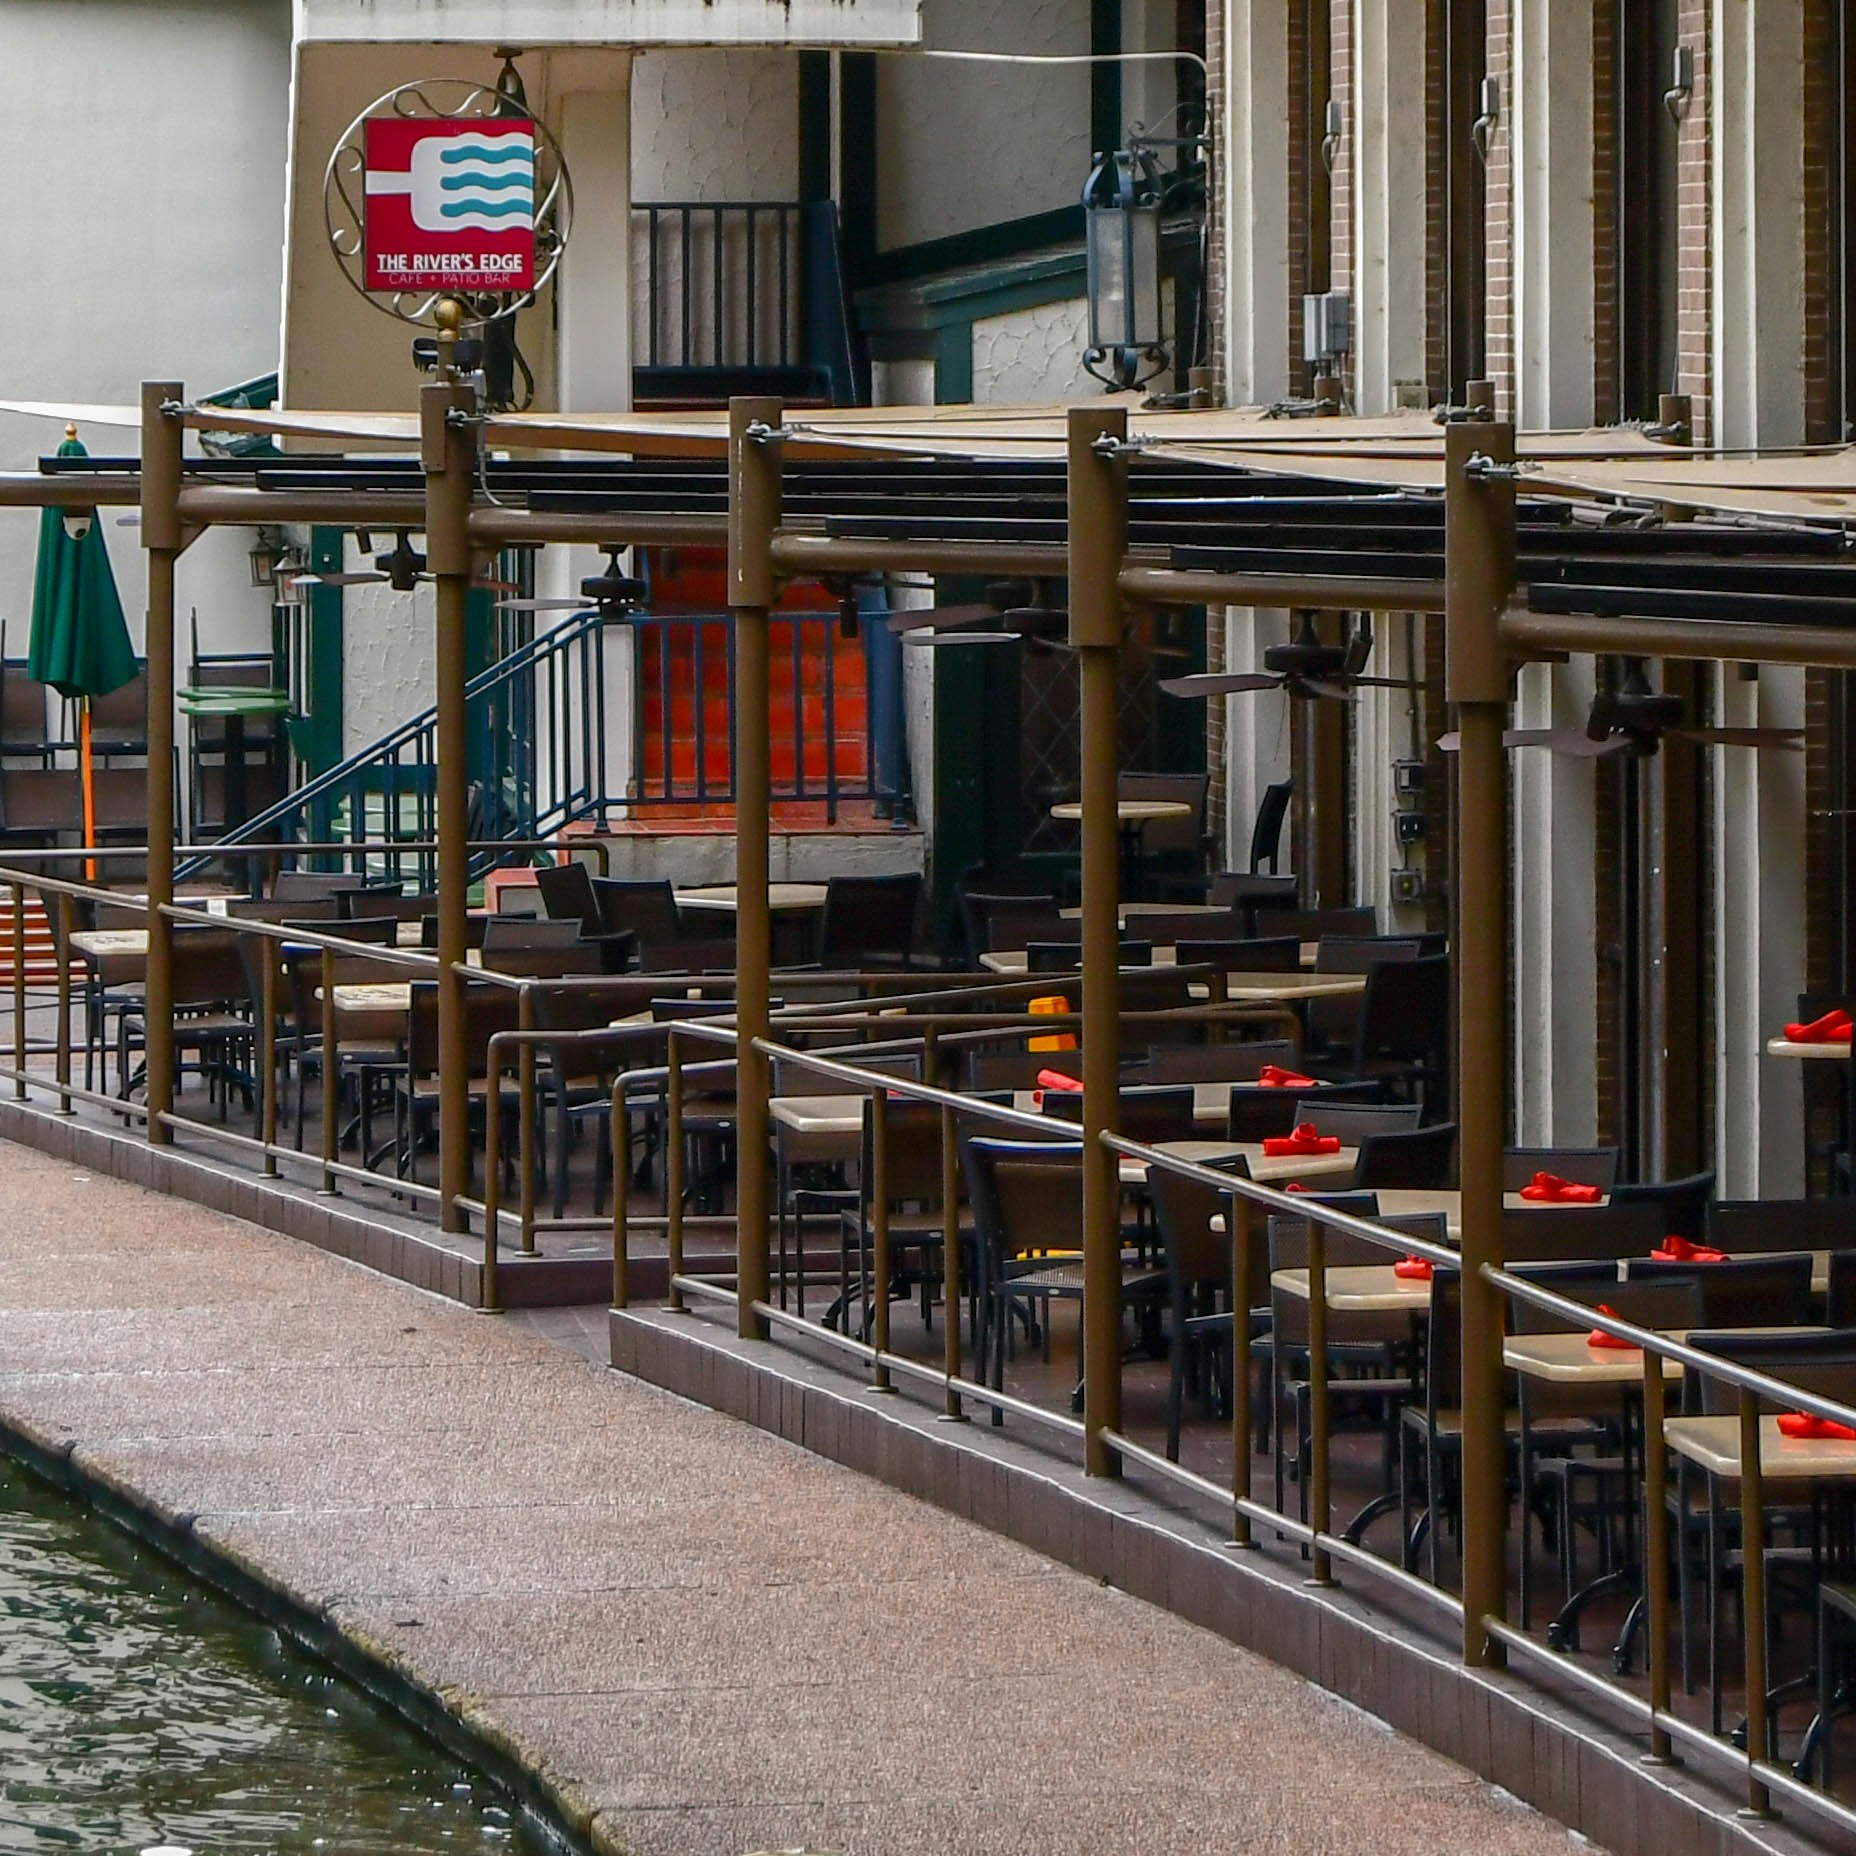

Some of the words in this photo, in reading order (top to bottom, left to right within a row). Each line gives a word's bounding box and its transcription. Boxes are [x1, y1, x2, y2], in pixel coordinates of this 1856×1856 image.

[377, 253, 407, 270] THE
[413, 252, 473, 270] RIVER'S
[479, 253, 523, 270] EDGE
[442, 273, 480, 285] PATIO
[484, 273, 511, 284] BAR
